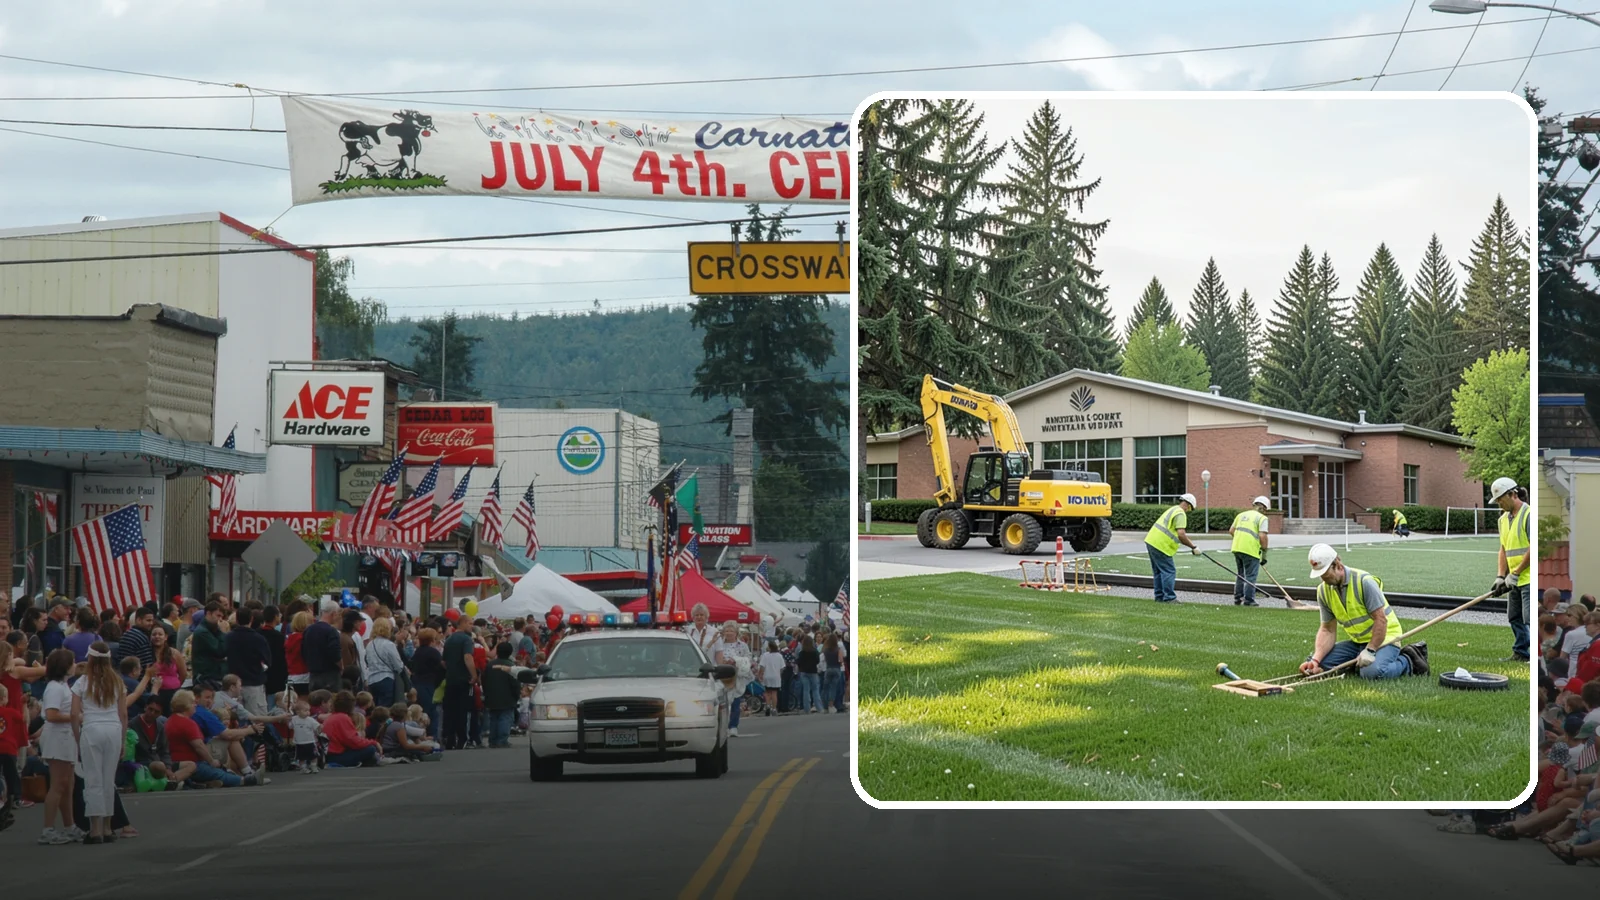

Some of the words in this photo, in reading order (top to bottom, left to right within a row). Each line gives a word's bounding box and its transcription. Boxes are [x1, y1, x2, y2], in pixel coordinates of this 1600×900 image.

[481, 140, 605, 192] JULY
[632, 150, 747, 198] 4th.
[697, 253, 850, 280] CROSSWA
[282, 380, 374, 420] ACE
[405, 409, 452, 421] CEDAR
[283, 421, 371, 436] Hardware
[416, 428, 477, 447] Coca-Cola
[353, 467, 385, 480] Simpl
[83, 485, 93, 494] St.
[96, 485, 124, 494] Vincent
[126, 486, 135, 494] de
[137, 486, 155, 495] Paul
[688, 526, 741, 535] CRNATION
[699, 535, 730, 543] GLASS
